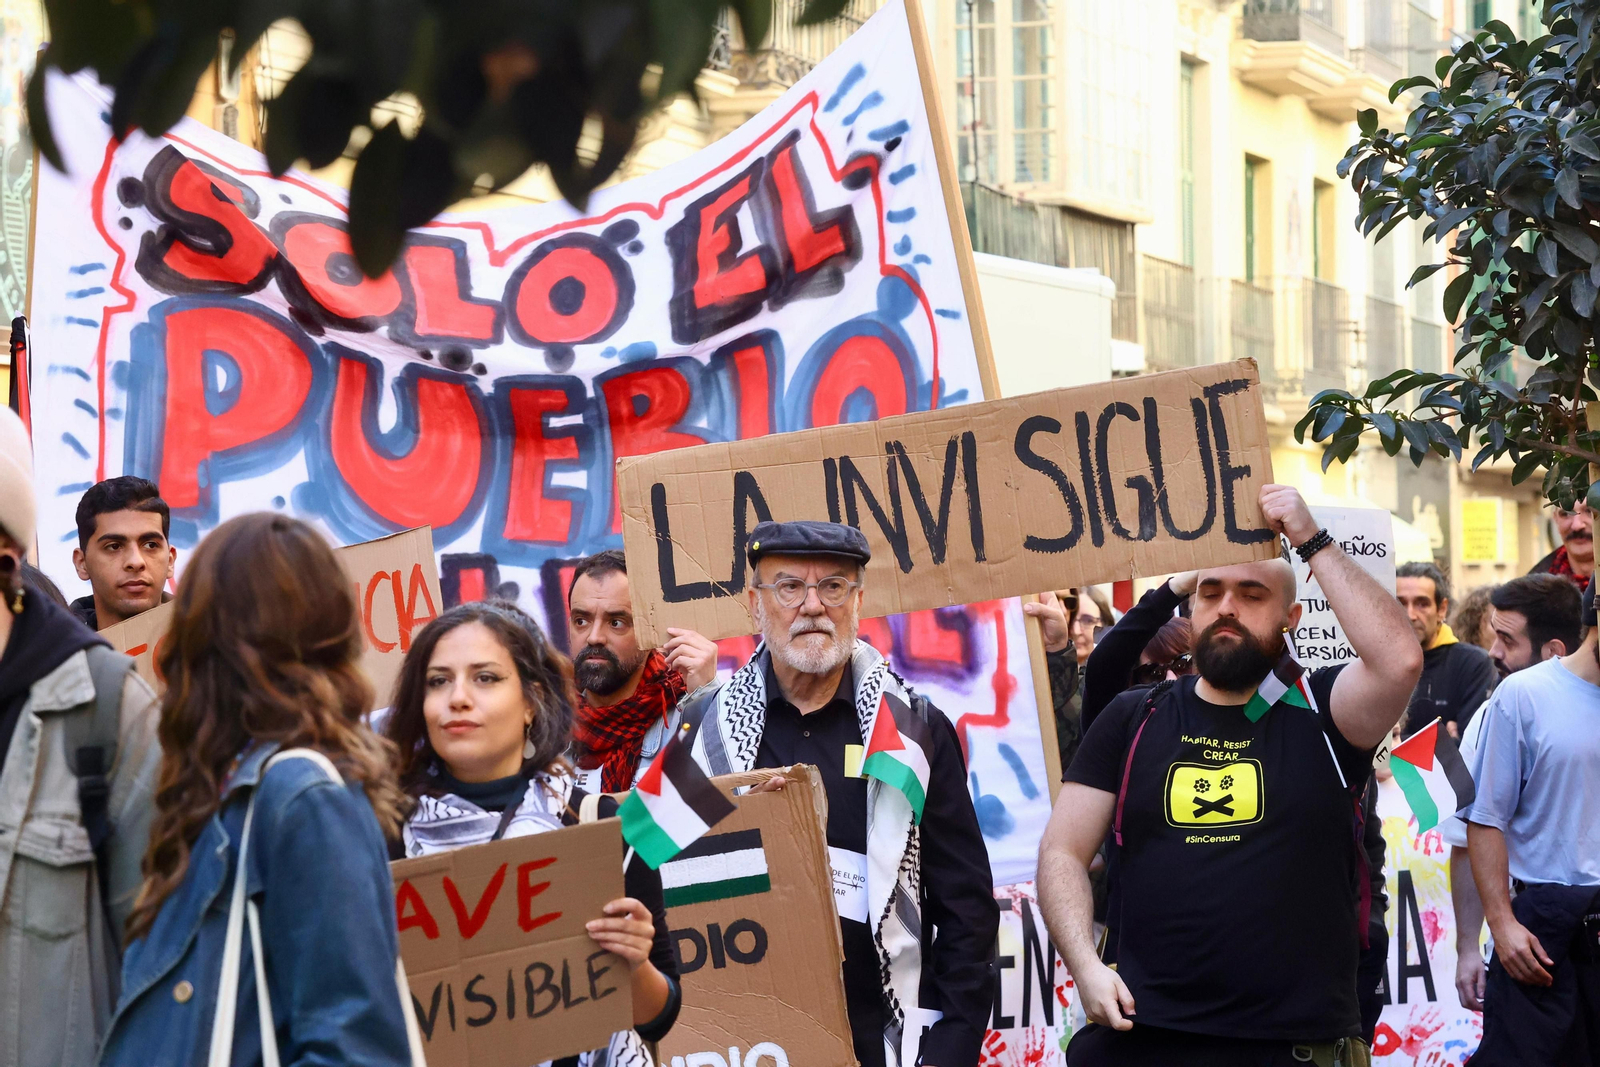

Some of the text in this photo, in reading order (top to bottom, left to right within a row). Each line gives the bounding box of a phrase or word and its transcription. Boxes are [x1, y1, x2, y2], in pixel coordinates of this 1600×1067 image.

[135, 128, 864, 348] SOLO EL
[650, 378, 1277, 603] LA INVI SIGUE
[355, 563, 437, 654] CIA
[1296, 626, 1337, 640] CEN
[1223, 738, 1254, 750] RESIST
[1203, 749, 1239, 761] CREAR
[1185, 834, 1241, 844] #SinCensura
[843, 872, 851, 880] EL
[396, 856, 563, 940] AVE
